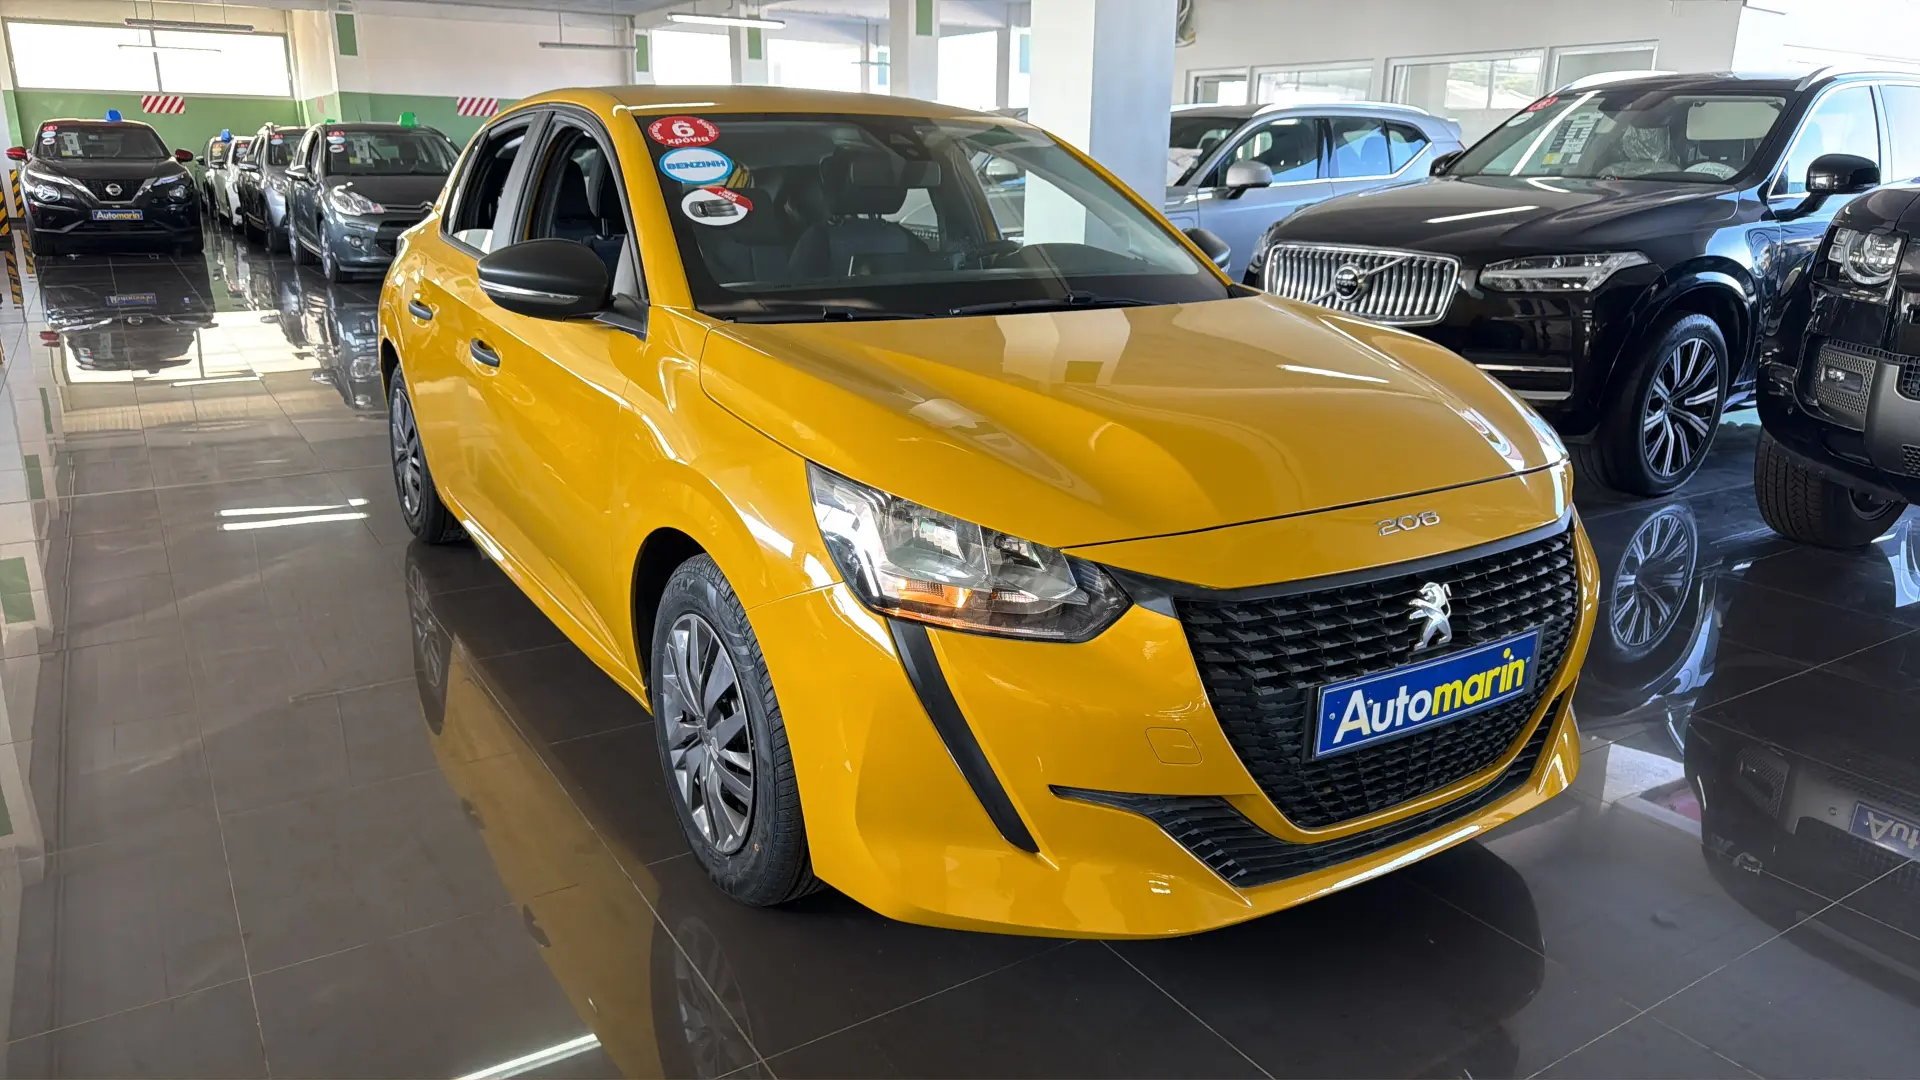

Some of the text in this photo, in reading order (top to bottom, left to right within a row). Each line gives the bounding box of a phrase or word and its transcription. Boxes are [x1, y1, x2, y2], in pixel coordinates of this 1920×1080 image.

[672, 122, 695, 137] 6
[667, 136, 710, 145] χρόνια
[97, 210, 140, 219] Automarin
[1332, 648, 1525, 744] Automarin
